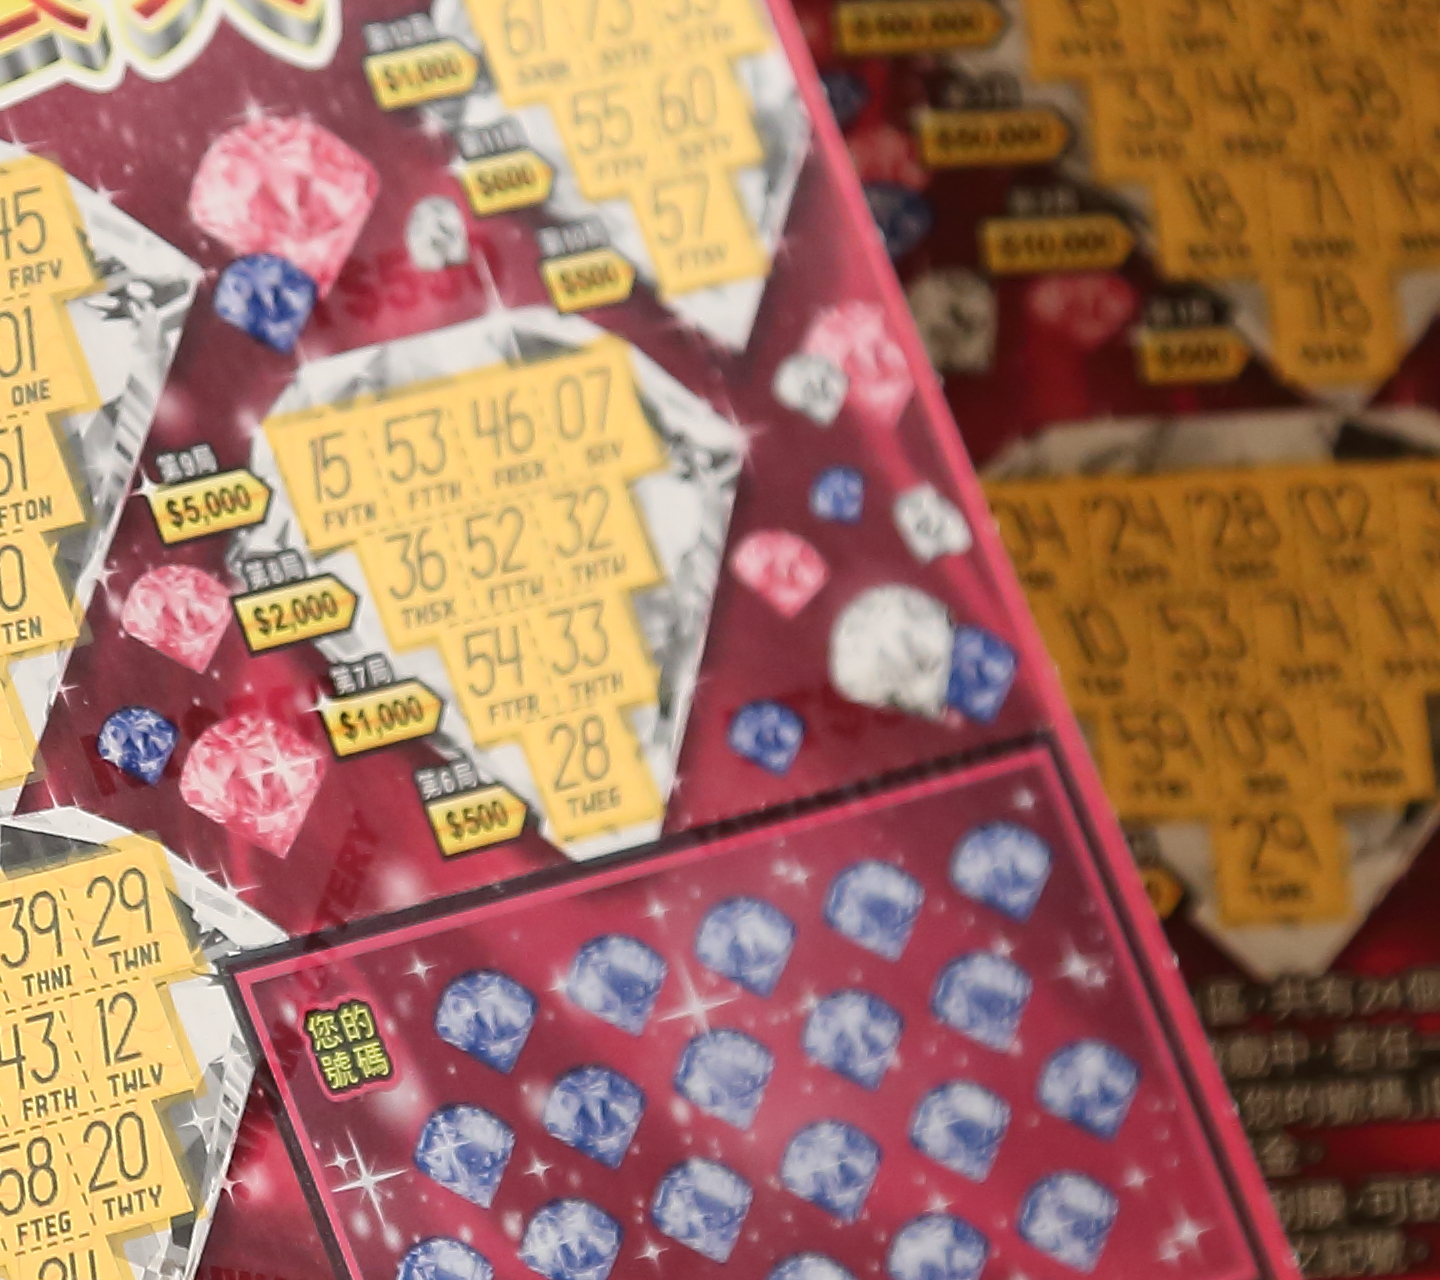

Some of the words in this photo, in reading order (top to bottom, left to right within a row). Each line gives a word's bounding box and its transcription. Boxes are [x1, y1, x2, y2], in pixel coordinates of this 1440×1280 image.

[308, 429, 353, 503] 15
[383, 407, 448, 485] 53
[471, 387, 537, 459] 46
[553, 366, 613, 443] 07
[163, 488, 253, 530] $5,000
[384, 526, 448, 602] 36
[463, 506, 528, 580] 52
[552, 484, 613, 559] 32
[2, 615, 44, 646] TEN
[252, 590, 340, 636] $2,000
[463, 626, 524, 699] 54
[547, 600, 611, 676] 33
[337, 697, 427, 742] $1,000
[548, 714, 611, 794] 28
[86, 866, 155, 949] 29
[20, 966, 75, 998] THNI
[94, 990, 143, 1068] 12
[306, 1004, 376, 1055] 您的
[320, 1037, 392, 1090] 號碼
[82, 1110, 149, 1196] 20
